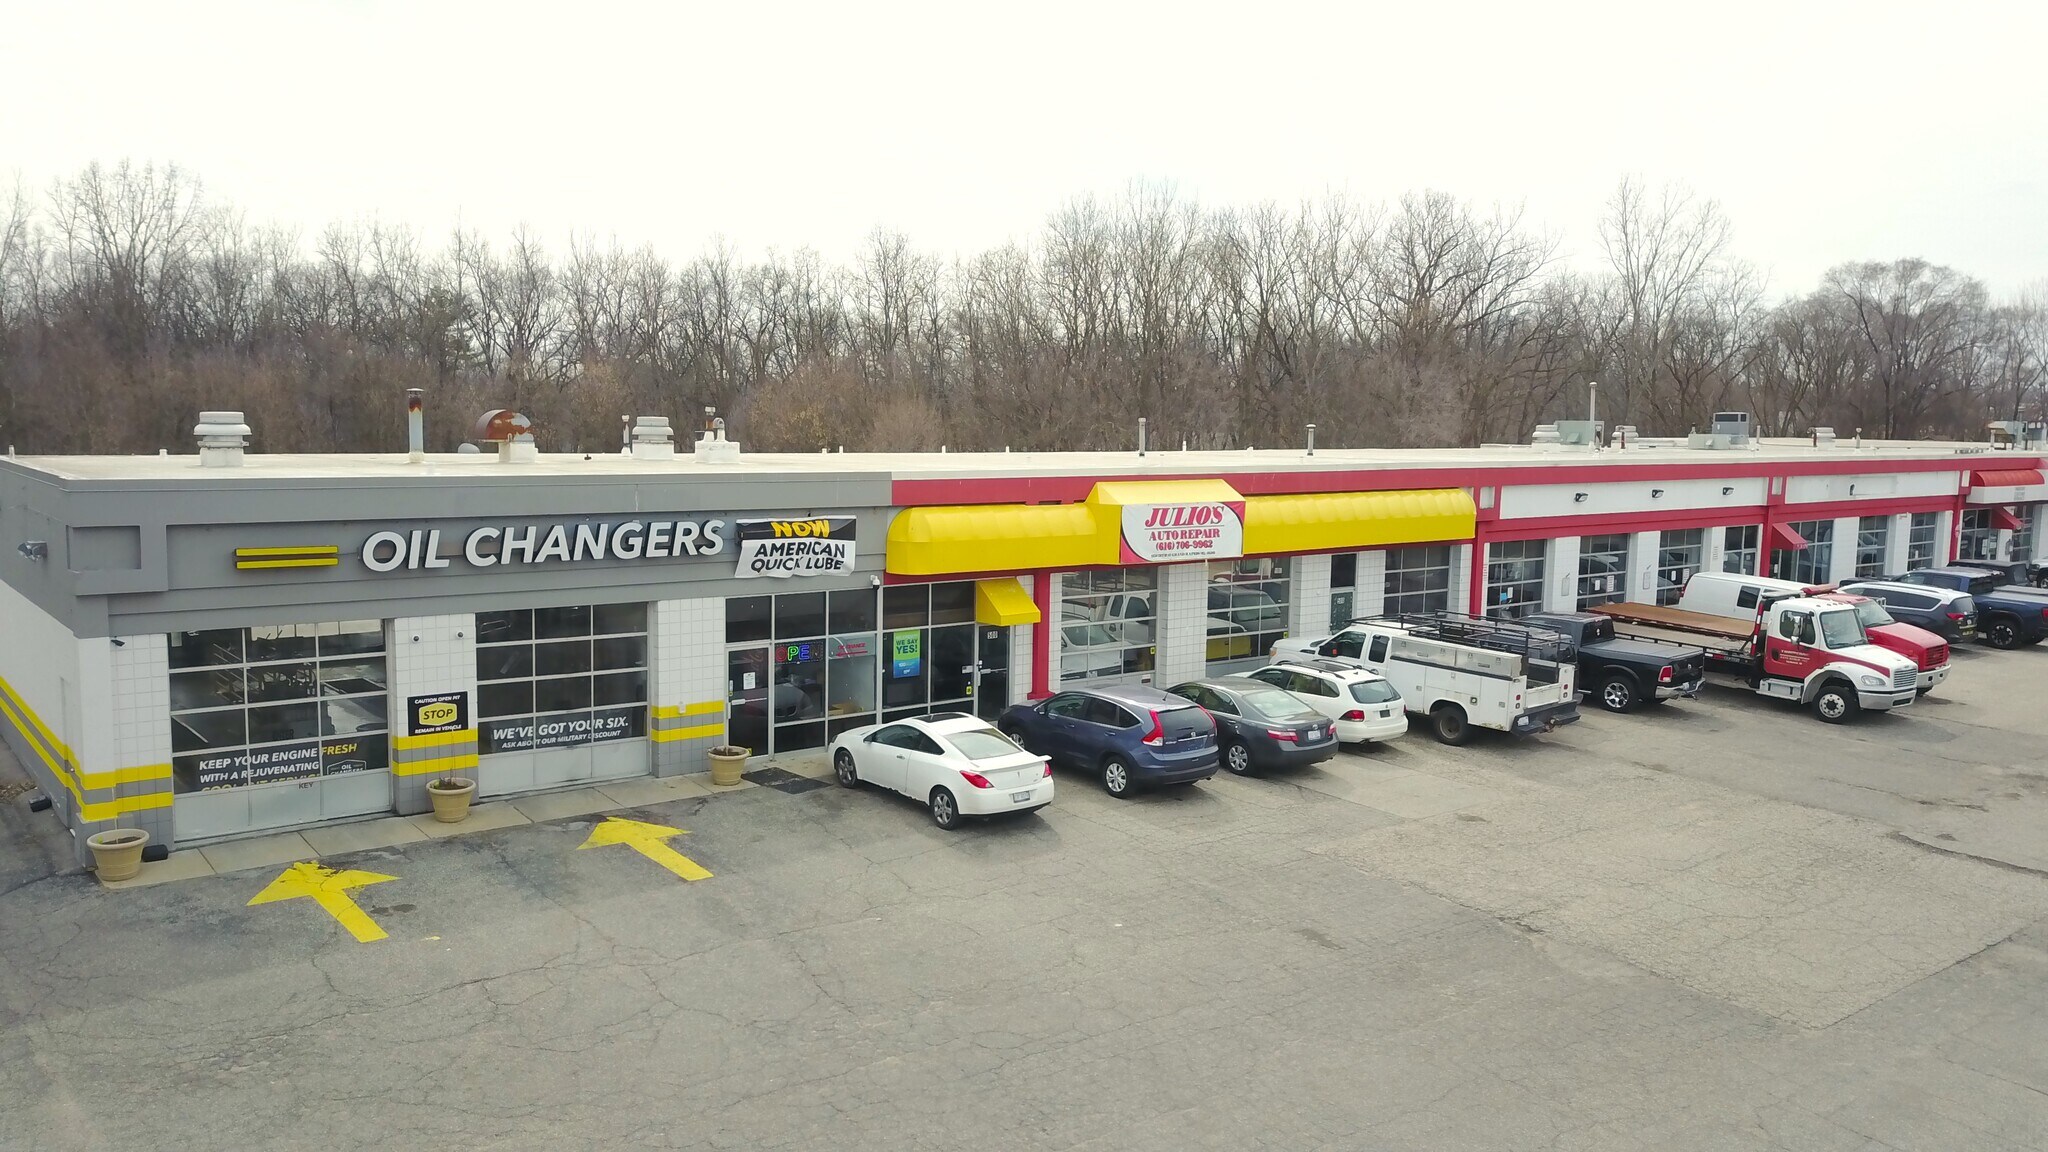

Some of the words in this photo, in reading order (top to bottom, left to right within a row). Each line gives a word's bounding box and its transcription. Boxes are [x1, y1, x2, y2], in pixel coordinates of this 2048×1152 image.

[770, 519, 830, 538] NOW
[1149, 530, 1179, 541] AUTO
[1180, 528, 1220, 539] REPAIR
[361, 529, 450, 572] OIL
[465, 519, 725, 567] CHANGERS
[754, 541, 845, 558] AMERICAN
[1156, 541, 1175, 551] (616)
[750, 557, 803, 573] QUICK
[805, 556, 844, 570] LUBE
[896, 644, 918, 654] YES!
[423, 708, 453, 720] STOP
[493, 726, 534, 740] WE'VE
[538, 722, 567, 736] GOT
[568, 719, 603, 733] YOUR
[606, 716, 629, 729] SIX.
[517, 739, 541, 747] ABOT
[587, 730, 621, 739] DSCOUNT
[199, 759, 231, 771] KEEP
[234, 753, 269, 766] YOUR
[272, 748, 318, 762] ENGINE
[321, 743, 358, 755] FRESH
[200, 772, 229, 784] WITH
[230, 771, 238, 780] A
[241, 761, 320, 778] REJUVENATING
[298, 781, 314, 790] KEY
